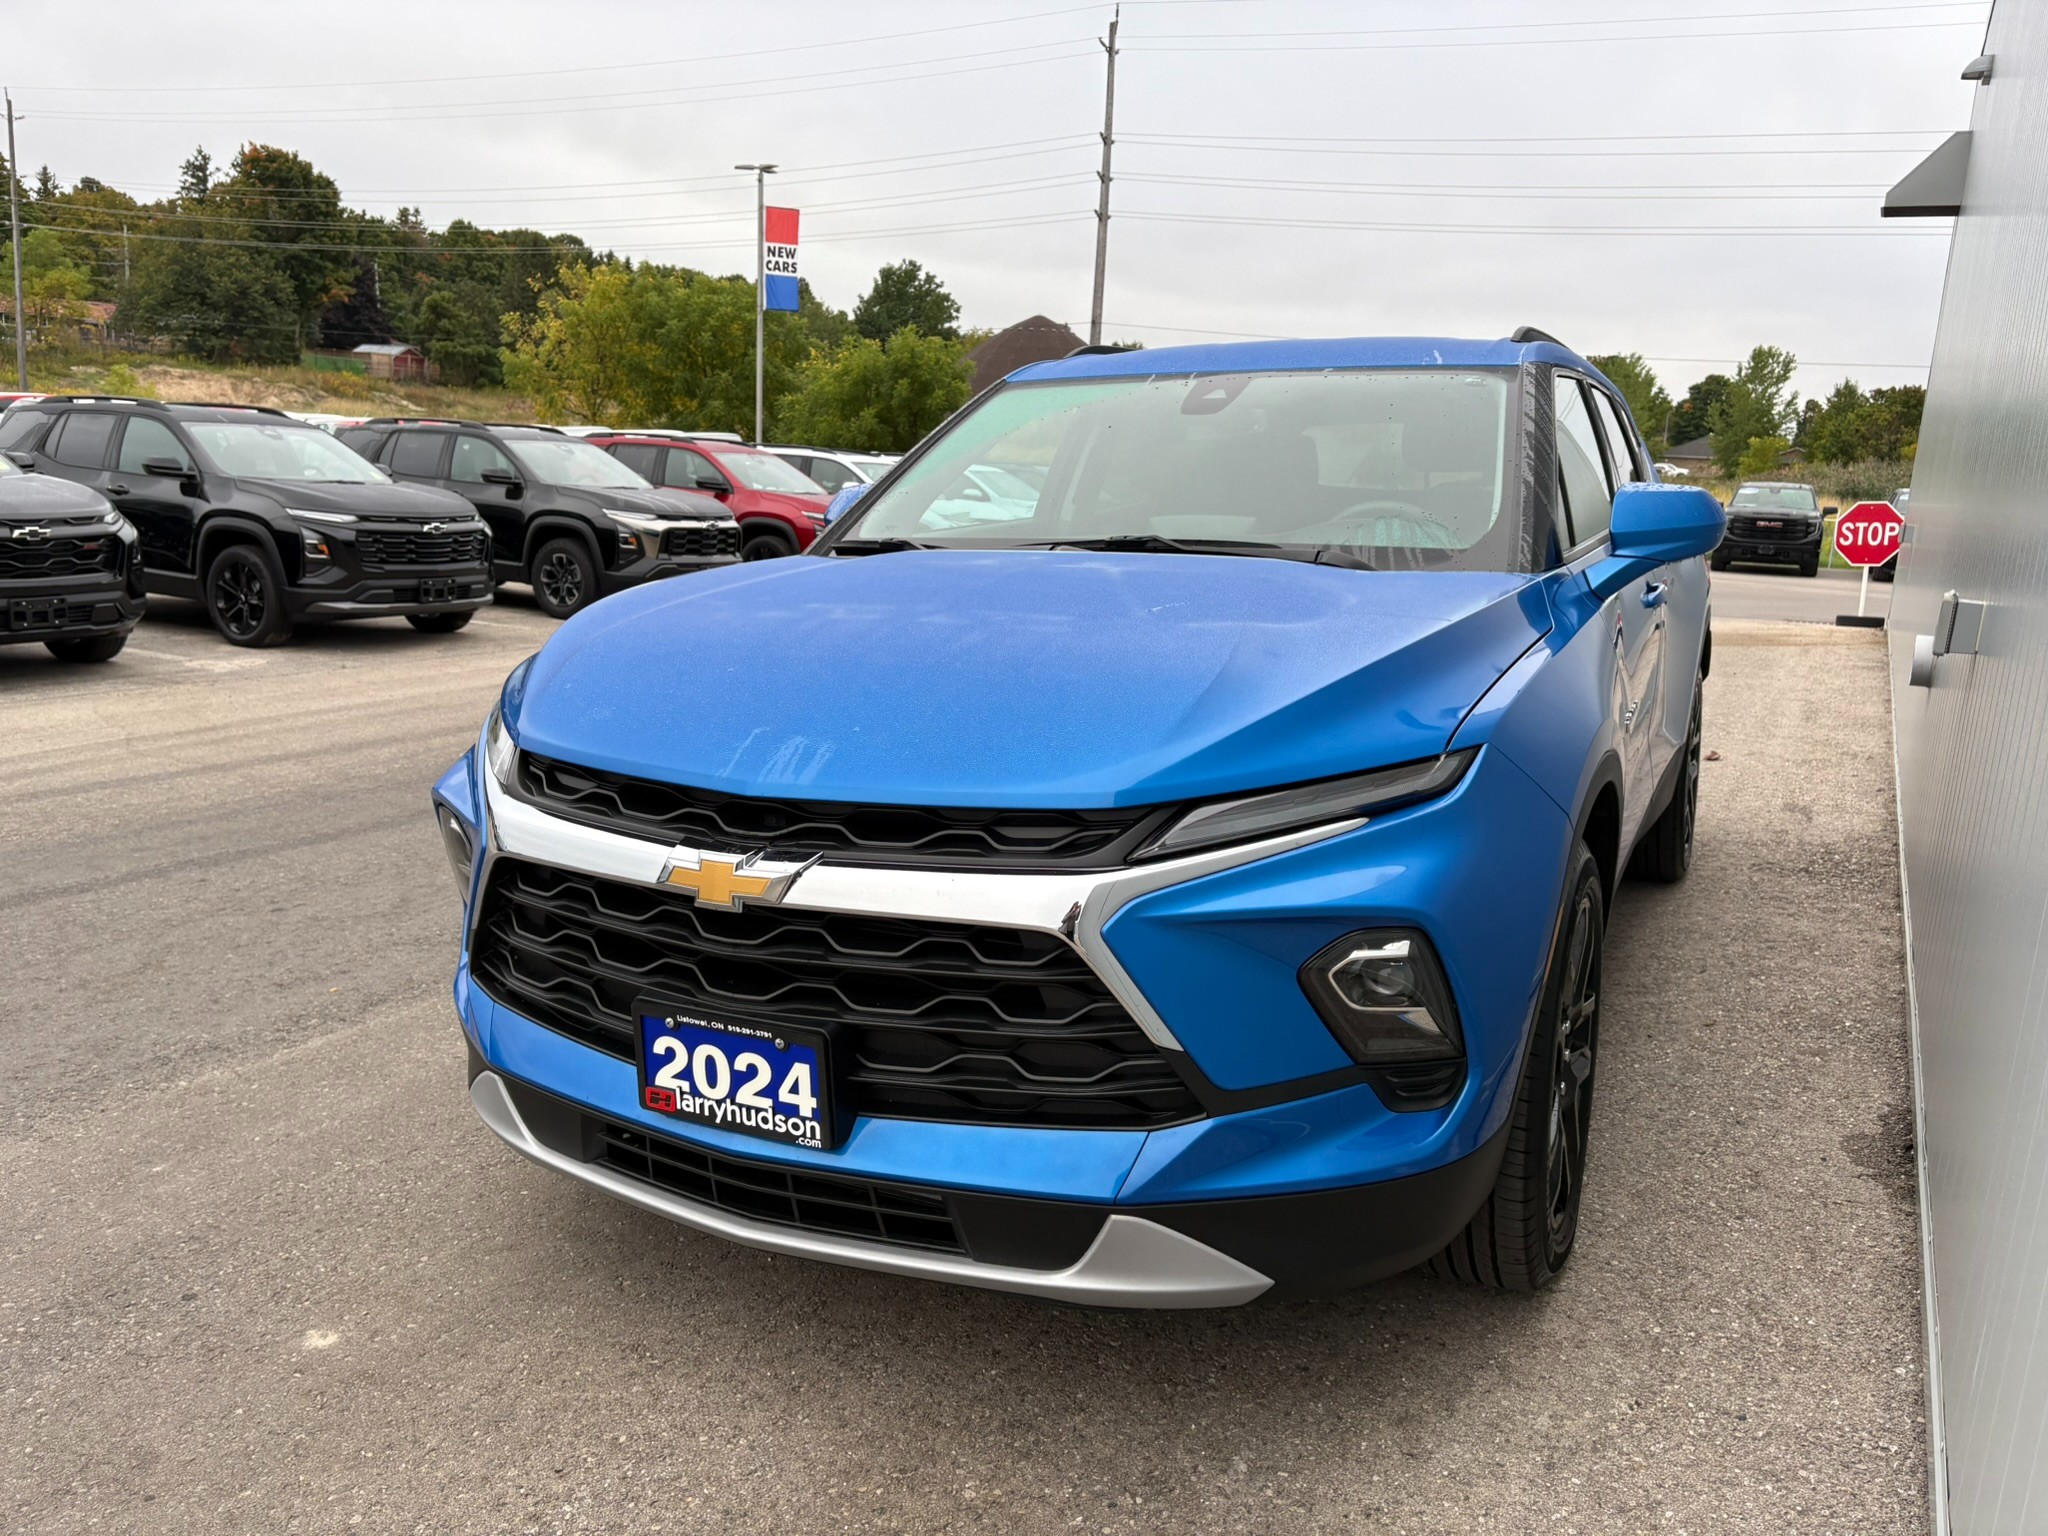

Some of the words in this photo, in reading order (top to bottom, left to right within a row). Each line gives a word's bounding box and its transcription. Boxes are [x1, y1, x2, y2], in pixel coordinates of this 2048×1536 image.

[767, 245, 797, 259] NEW
[765, 260, 798, 273] CARS
[1756, 520, 1783, 528] GMC
[1839, 521, 1900, 546] STOP
[711, 1021, 725, 1030] ON
[652, 1035, 817, 1118] 2024
